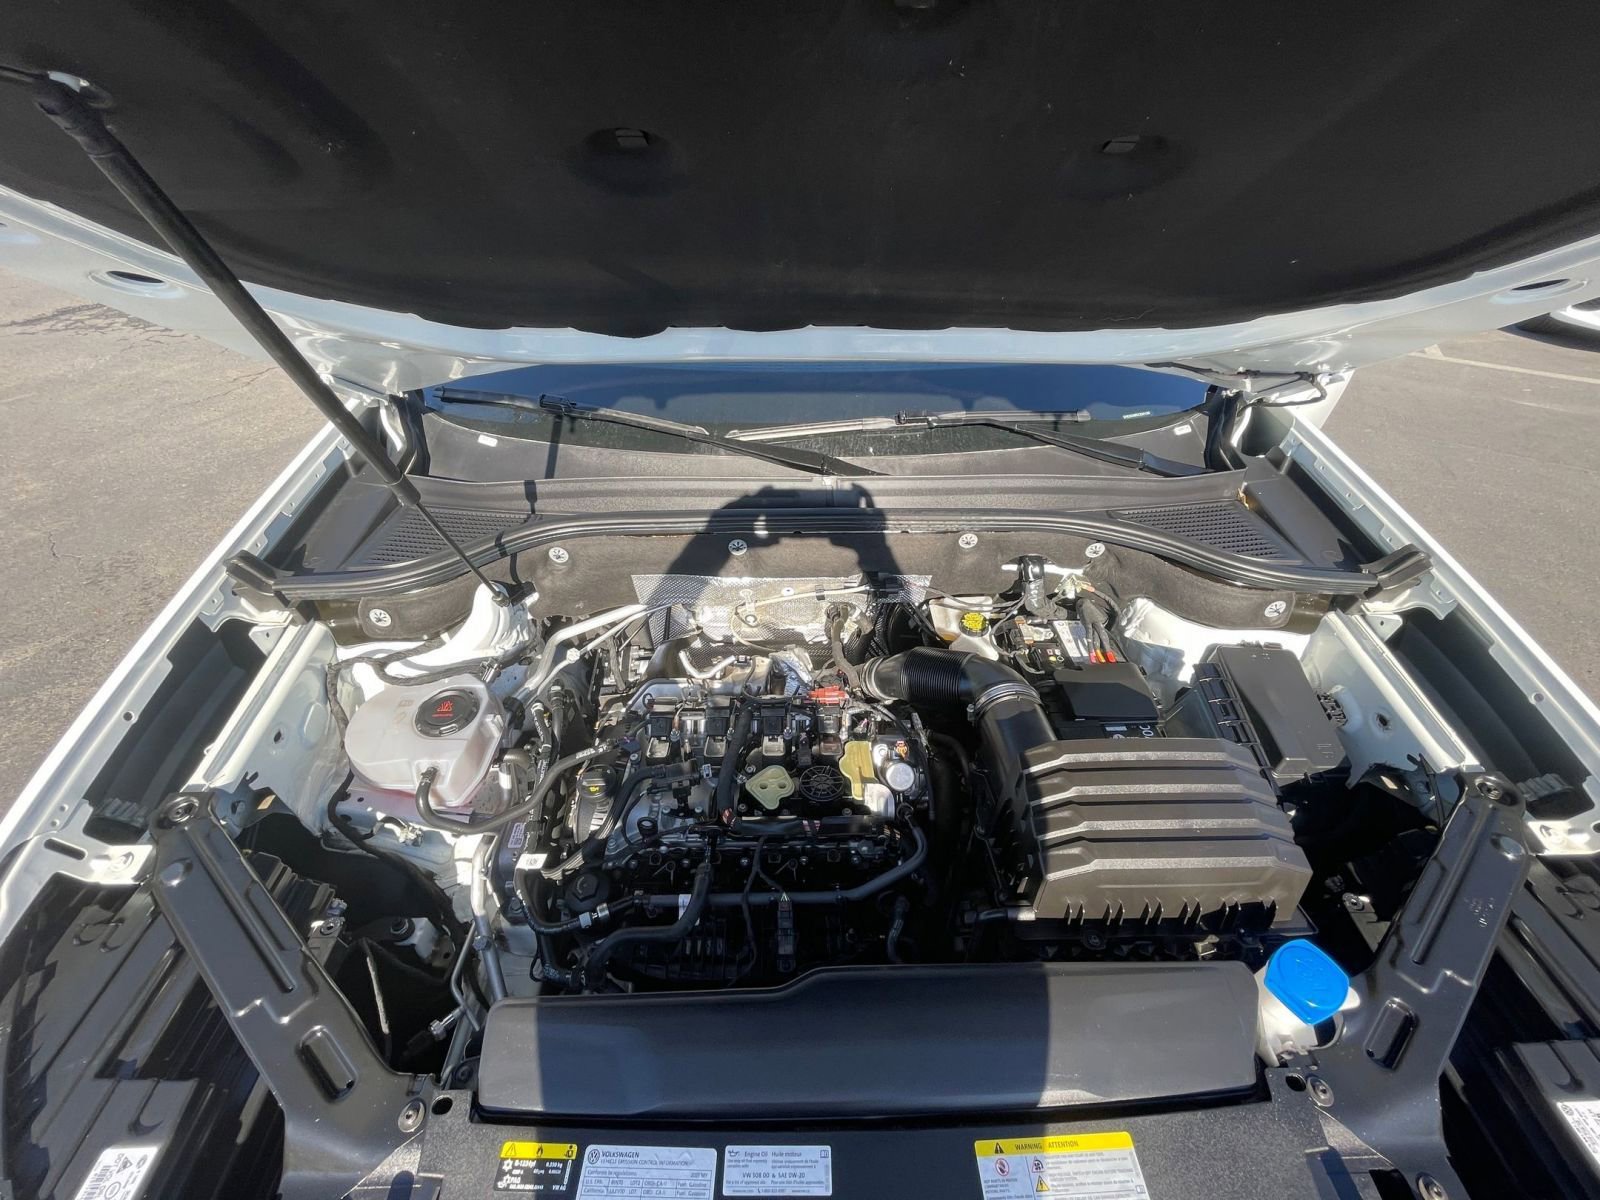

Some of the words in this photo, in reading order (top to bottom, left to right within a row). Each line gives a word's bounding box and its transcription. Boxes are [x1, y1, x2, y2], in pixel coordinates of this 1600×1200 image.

[1014, 1143, 1043, 1151] WARNING
[1048, 1140, 1079, 1149] ATTENTION
[601, 1150, 640, 1158] VOLKSWAGEN
